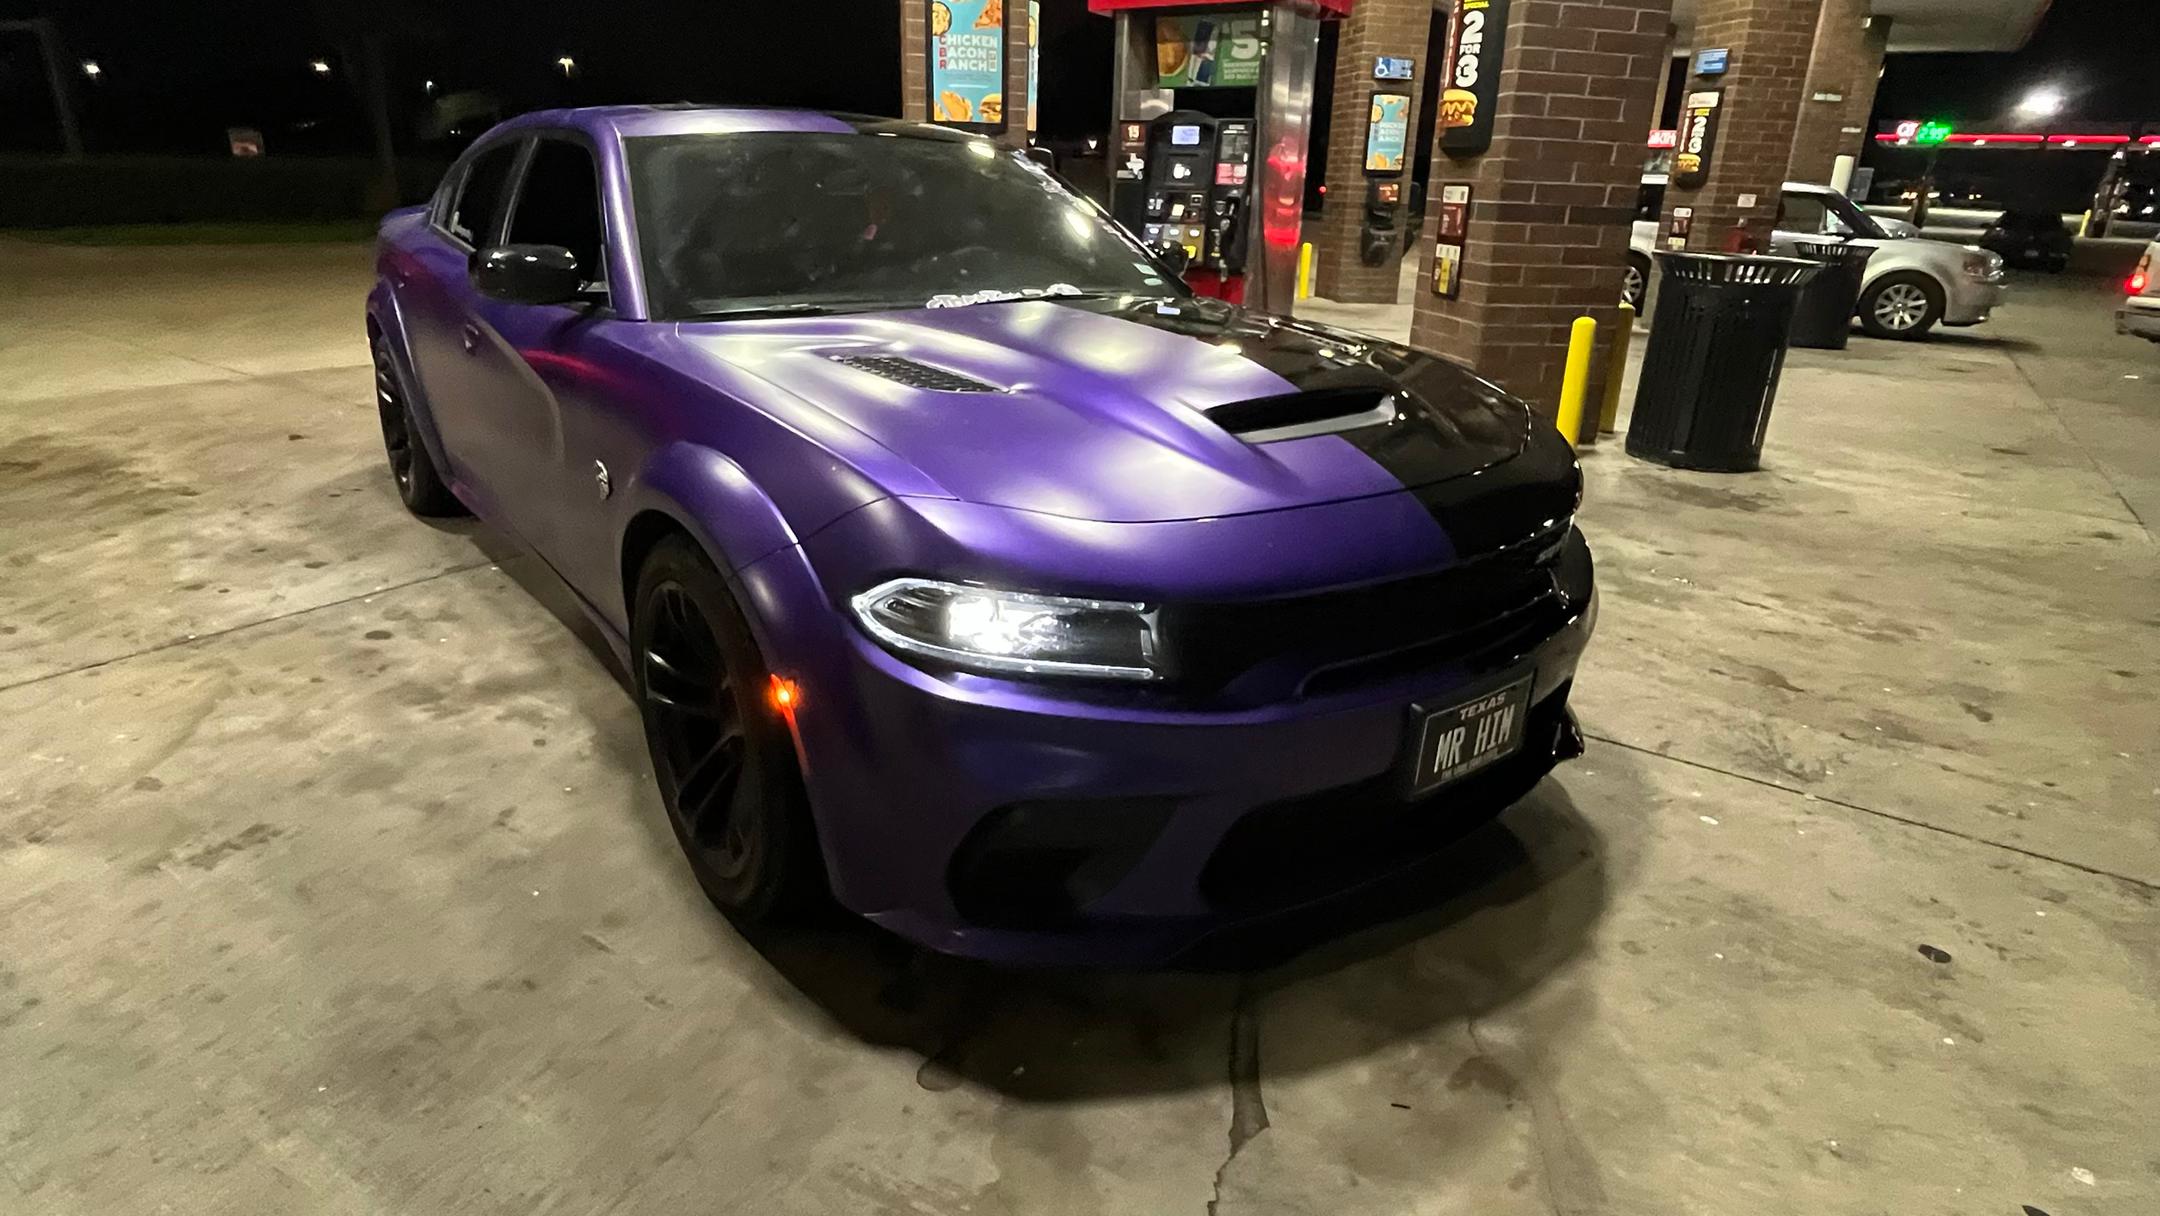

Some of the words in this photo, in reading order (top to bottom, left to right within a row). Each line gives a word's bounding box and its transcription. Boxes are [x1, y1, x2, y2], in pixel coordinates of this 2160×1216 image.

[1460, 10, 1485, 44] 2
[939, 34, 998, 48] CHICKEN
[939, 47, 987, 59] BACON
[1459, 43, 1481, 55] FOR
[939, 59, 988, 71] RANCH
[1460, 692, 1506, 720] TEXAS
[1434, 727, 1466, 773] MR
[1474, 704, 1515, 756] HIM
